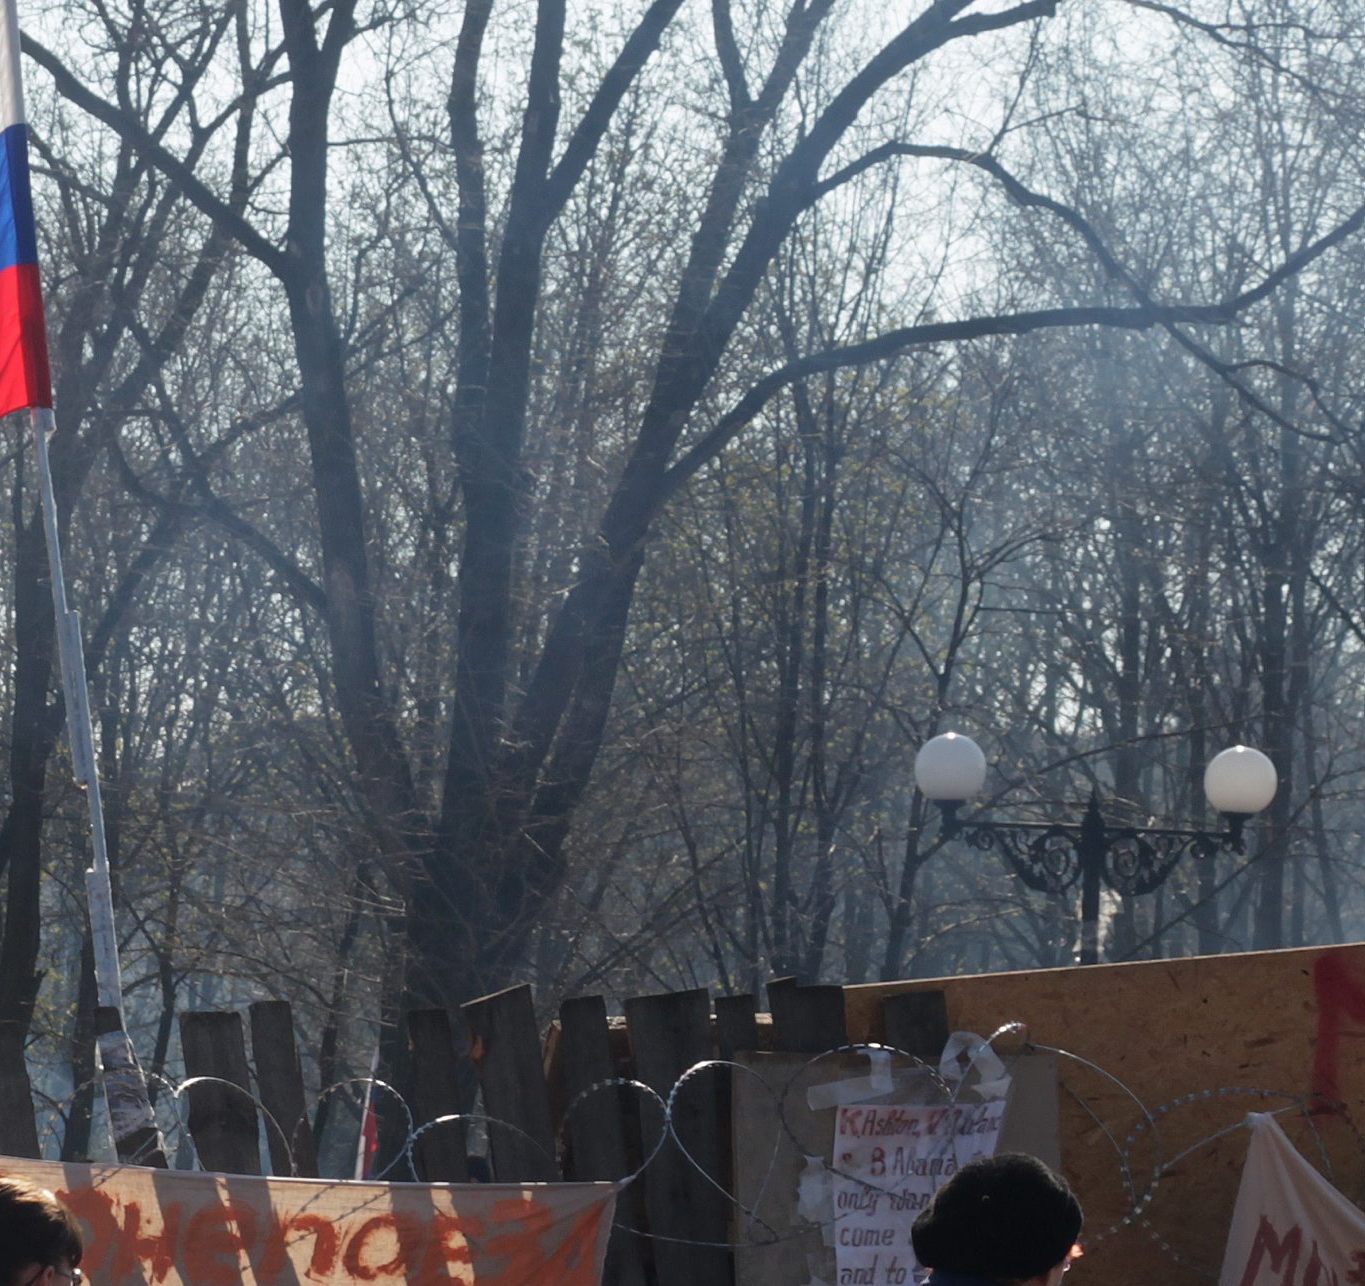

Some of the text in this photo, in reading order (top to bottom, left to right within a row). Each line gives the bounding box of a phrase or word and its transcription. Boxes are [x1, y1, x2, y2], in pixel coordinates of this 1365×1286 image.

[889, 1189, 933, 1211] wan
[840, 1226, 895, 1247] come
[840, 1255, 875, 1285] and
[884, 1258, 907, 1283] to
